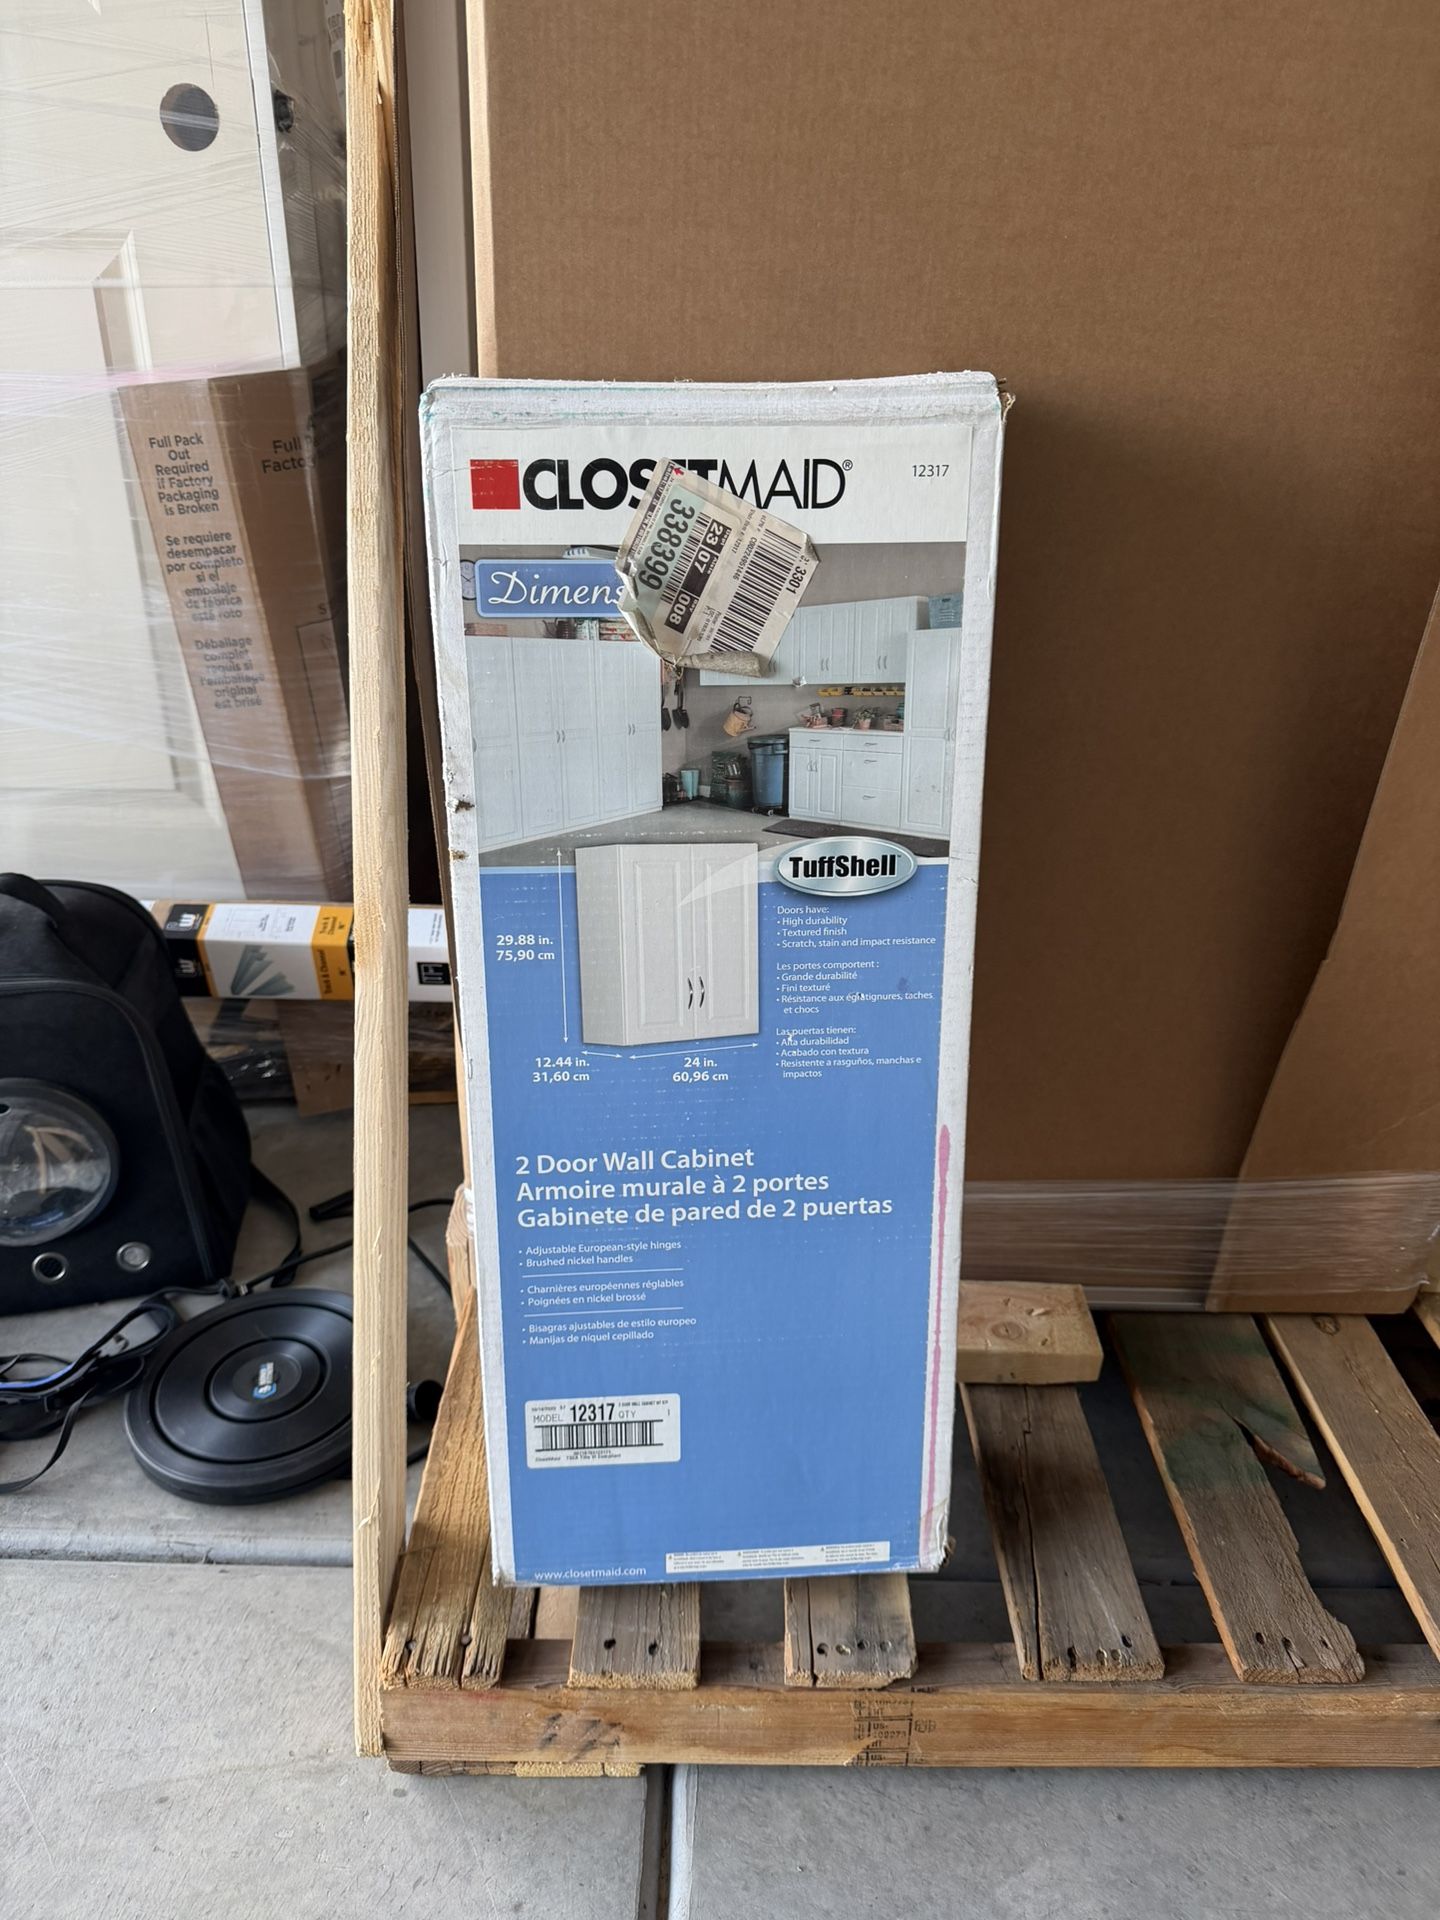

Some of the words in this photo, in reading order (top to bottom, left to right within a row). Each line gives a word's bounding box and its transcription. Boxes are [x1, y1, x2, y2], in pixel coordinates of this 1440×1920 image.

[148, 435, 172, 449] Full
[174, 432, 204, 447] Pack
[273, 436, 302, 454] Full
[168, 448, 191, 461] Out
[155, 460, 209, 476] Required
[912, 464, 950, 478] 12317
[157, 477, 165, 489] if
[168, 476, 213, 488] Factory
[158, 487, 219, 503] Packaging
[164, 504, 175, 516] is
[177, 500, 219, 515] Broken
[165, 535, 180, 546] Se
[183, 531, 232, 546] requiere
[705, 522, 724, 546] 23
[638, 498, 695, 590] 338399
[167, 545, 236, 559] desempacar
[693, 551, 711, 573] 07
[166, 563, 185, 575] por
[785, 565, 807, 594] 3301
[668, 593, 691, 625] 008
[789, 854, 896, 878] TuffShell
[777, 905, 804, 915] Doors
[805, 905, 830, 914] have:
[782, 917, 804, 927] High
[805, 916, 848, 926] durability
[782, 928, 821, 937] Textured
[823, 927, 848, 936] finish
[496, 934, 535, 946] 29.88
[538, 934, 553, 946] in.
[782, 939, 817, 949] Scratch,
[818, 938, 840, 947] stain
[841, 937, 858, 946] and
[860, 937, 891, 948] impact
[892, 936, 937, 945] resistance
[496, 950, 535, 962] 75,90
[537, 951, 555, 961] cm
[776, 962, 792, 971] Les
[793, 962, 821, 972] portes
[822, 961, 875, 972] comportent
[781, 973, 814, 982] Grande
[815, 972, 858, 981] durabilité
[781, 984, 798, 992] Fini
[799, 983, 831, 992] texturé
[781, 994, 826, 1003] Résistance
[904, 991, 933, 1000] taches
[783, 1006, 793, 1014] et
[794, 1005, 820, 1014] chocs
[776, 1028, 790, 1036] Las
[792, 1027, 825, 1038] puertas
[826, 1026, 857, 1035] tienen:
[800, 1036, 849, 1046] durabilidad
[781, 1048, 819, 1057] Acabado
[820, 1048, 836, 1056] con
[838, 1046, 869, 1055] textura
[535, 1057, 573, 1068] 12.44
[575, 1056, 590, 1067] in.
[684, 1057, 700, 1068] 24
[703, 1056, 717, 1067] in.
[781, 1059, 824, 1068] Resistente
[833, 1057, 875, 1068] rasguños,
[875, 1056, 915, 1065] manchas
[532, 1071, 570, 1084] 31,60
[573, 1073, 590, 1082] cm
[672, 1071, 710, 1083] 60,96
[712, 1072, 729, 1081] cm
[783, 1070, 822, 1079] impactos
[515, 1156, 530, 1175] 2
[537, 1154, 597, 1175] Door
[602, 1150, 654, 1172] Wall
[661, 1148, 755, 1169] Cabinet
[516, 1181, 616, 1202] Armoire
[622, 1175, 706, 1198] murale
[712, 1175, 726, 1194] à
[732, 1174, 746, 1193] 2
[753, 1172, 829, 1197] portes
[517, 1207, 629, 1228] Gabinete
[634, 1204, 665, 1223] de
[672, 1201, 740, 1227] pared
[746, 1199, 776, 1218] de
[782, 1199, 796, 1217] 2
[802, 1196, 893, 1221] puertas
[526, 1244, 576, 1256] Adjustable
[578, 1242, 649, 1254] European-style
[650, 1241, 682, 1252] hinges
[526, 1257, 565, 1267] Brushed
[567, 1256, 595, 1265] nickel
[596, 1254, 634, 1264] handles
[527, 1283, 577, 1294] Charnières
[579, 1281, 640, 1293] européennes
[642, 1279, 684, 1291] réglables
[528, 1297, 570, 1308] Poignées
[586, 1294, 614, 1304] nickel
[615, 1292, 646, 1302] brossé
[529, 1323, 567, 1334] Bisagras
[568, 1321, 615, 1333] ajustables
[617, 1319, 630, 1328] de
[631, 1318, 656, 1328] estilo
[657, 1317, 697, 1328] europeo
[529, 1335, 565, 1347] Manijas
[567, 1334, 579, 1343] de
[612, 1330, 654, 1342] cepillado
[533, 1413, 564, 1423] MODEL
[570, 1403, 615, 1422] 12317
[618, 1410, 637, 1419] QTY
[535, 1565, 647, 1580] www.closetmaid.com
